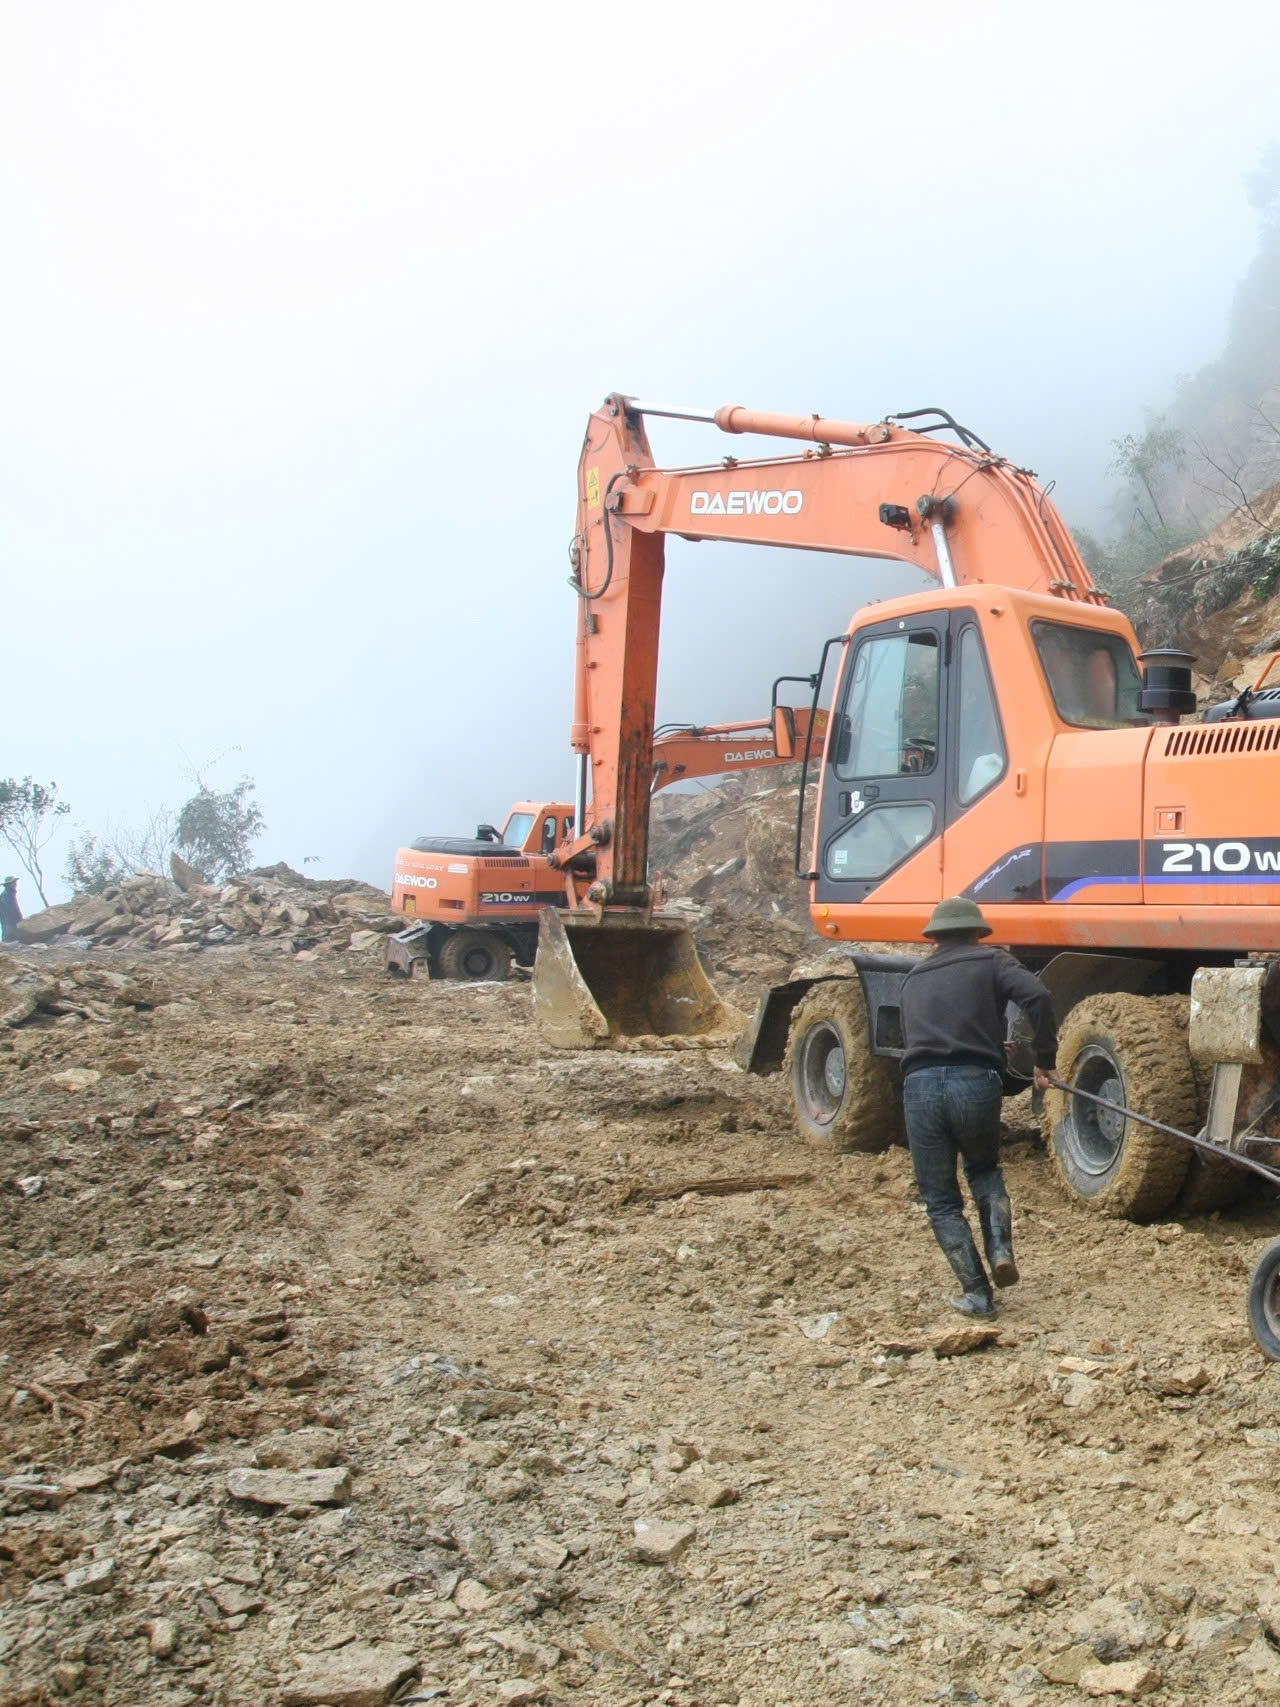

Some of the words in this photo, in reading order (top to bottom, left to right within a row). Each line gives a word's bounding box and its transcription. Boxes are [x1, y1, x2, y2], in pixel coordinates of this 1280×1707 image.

[690, 489, 803, 515] DAEWOO
[394, 871, 438, 889] DAEWOO
[973, 849, 1032, 894] SOLAR
